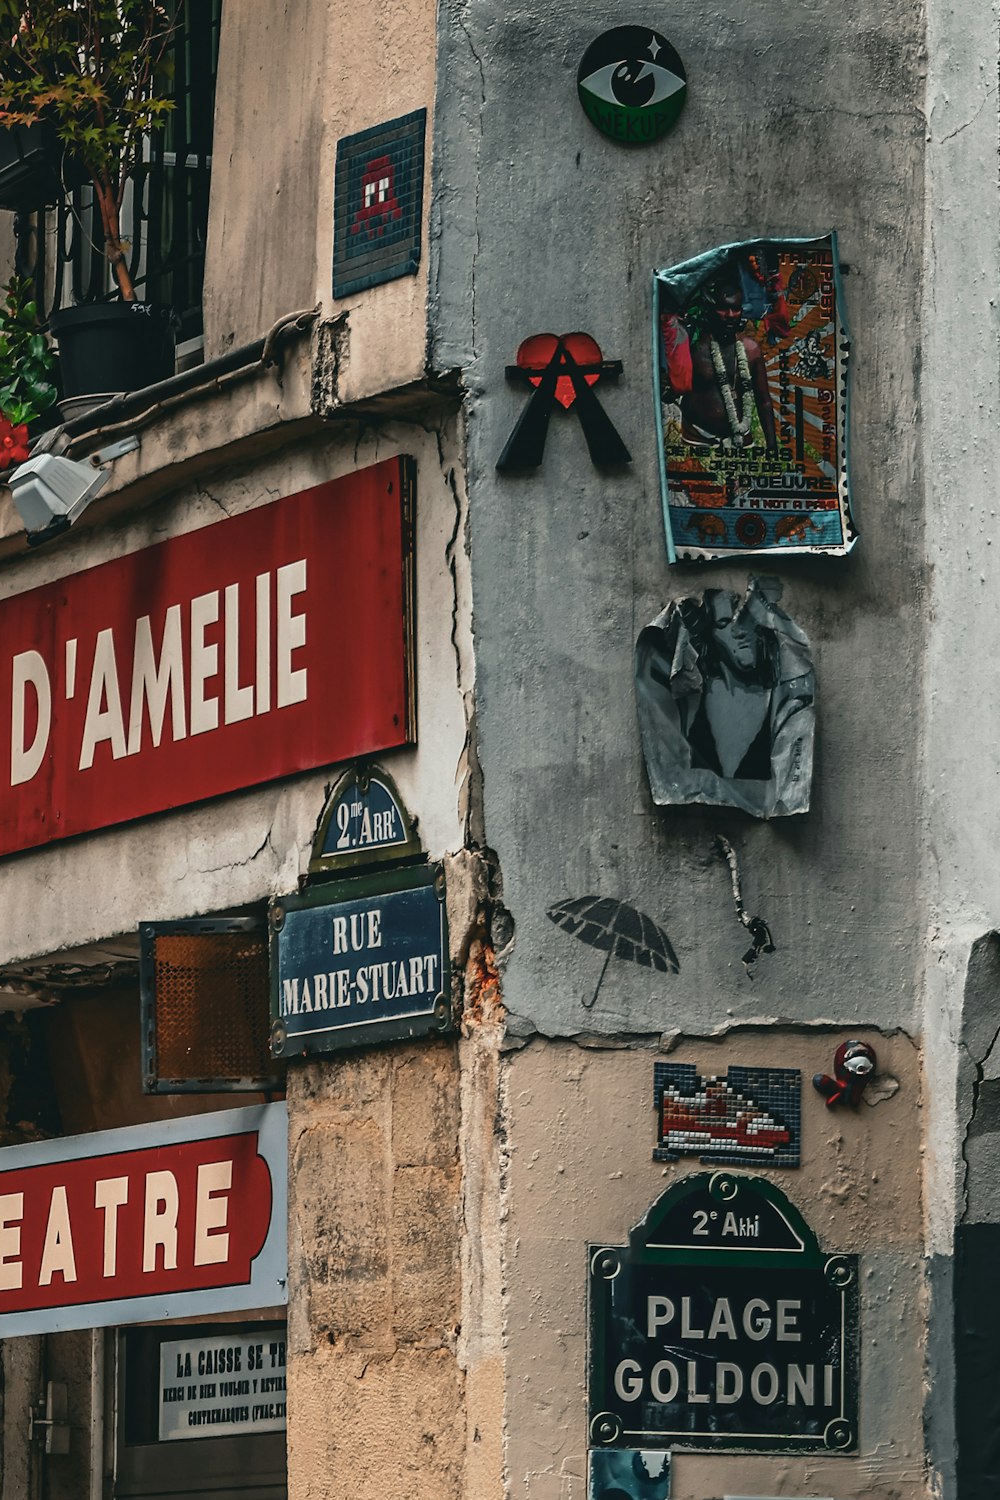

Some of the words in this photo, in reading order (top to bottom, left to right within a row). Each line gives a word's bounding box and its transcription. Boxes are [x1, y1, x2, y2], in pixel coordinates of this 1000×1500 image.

[752, 447, 793, 461] PAS
[762, 461, 782, 472] DE
[763, 499, 789, 508] NOT
[11, 559, 307, 787] D'AMELIE
[333, 910, 382, 955] RUE
[283, 954, 438, 1017] MARIE-STUART
[647, 1295, 801, 1342] PLAGE
[176, 1352, 192, 1378] LA
[198, 1346, 241, 1376] CAISSE
[247, 1344, 263, 1371] SE
[187, 1385, 197, 1401] DE
[252, 1379, 258, 1394] Y
[614, 1358, 833, 1406] GOLDONI
